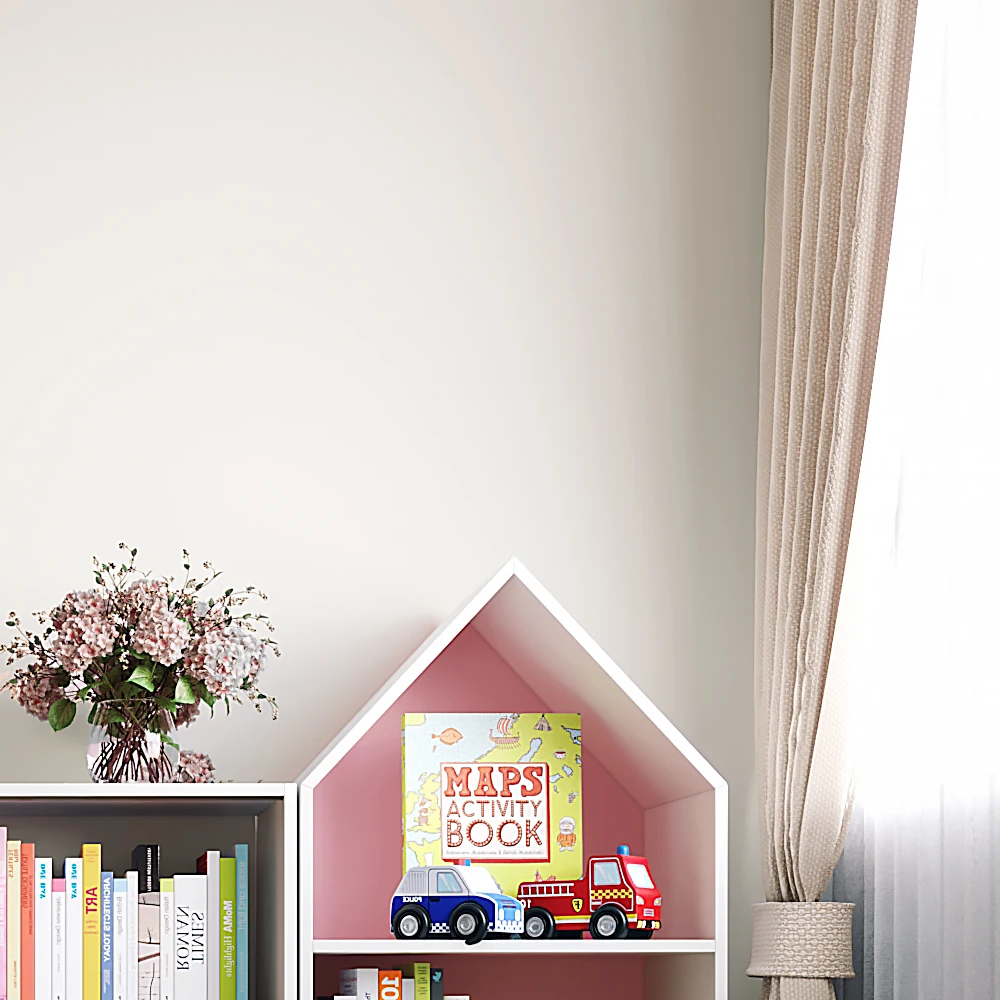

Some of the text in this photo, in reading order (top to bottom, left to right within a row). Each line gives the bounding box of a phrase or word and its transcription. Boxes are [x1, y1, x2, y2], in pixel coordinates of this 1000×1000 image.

[443, 766, 543, 797] MAPS
[446, 800, 542, 818] ACTIVITY
[446, 819, 543, 847] BOOK
